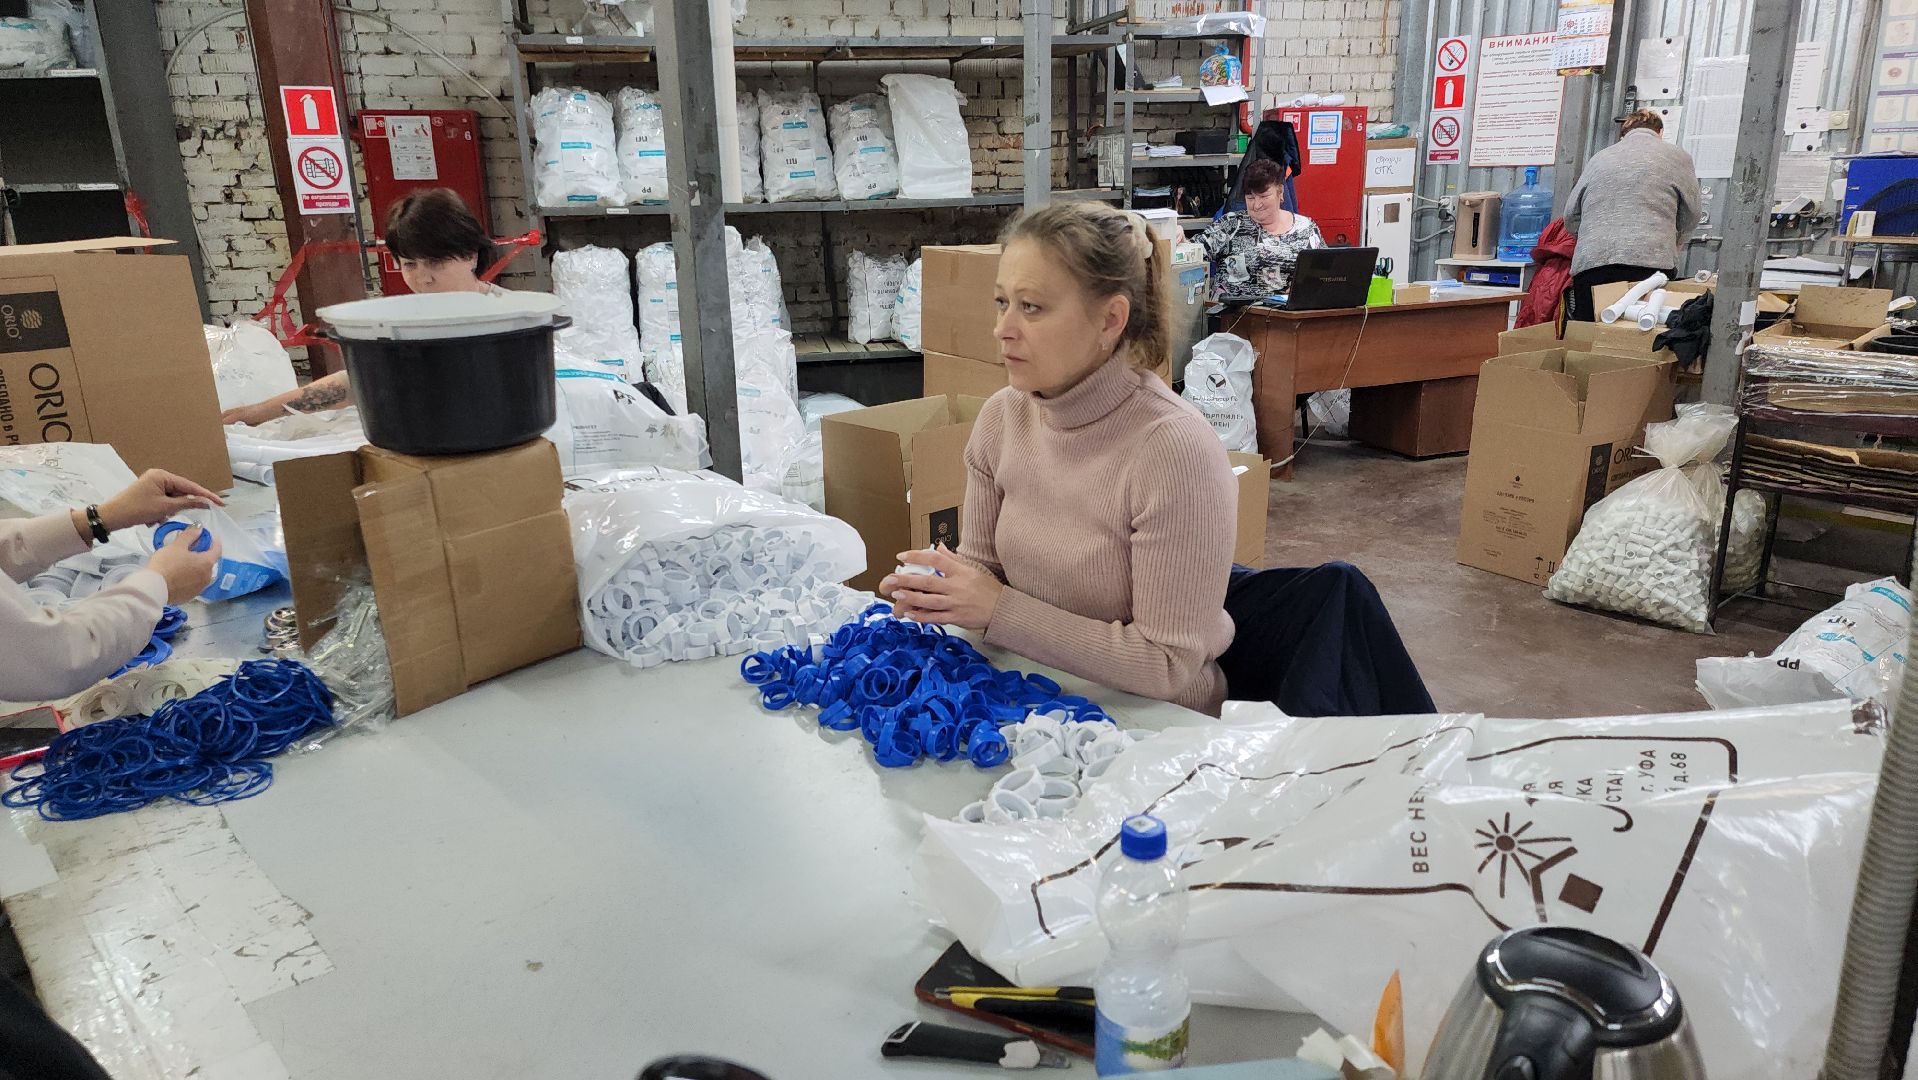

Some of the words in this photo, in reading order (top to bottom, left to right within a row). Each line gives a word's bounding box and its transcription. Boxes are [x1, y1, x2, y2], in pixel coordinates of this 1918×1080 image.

[464, 130, 472, 141] 6
[1356, 122, 1363, 132] 5
[1, 304, 19, 338] ORIO
[1638, 749, 1656, 779] УФА
[1669, 751, 1689, 784] д.68
[1575, 777, 1593, 796] КА
[1407, 789, 1426, 821] НЕ
[1409, 830, 1430, 873] ВЕС
